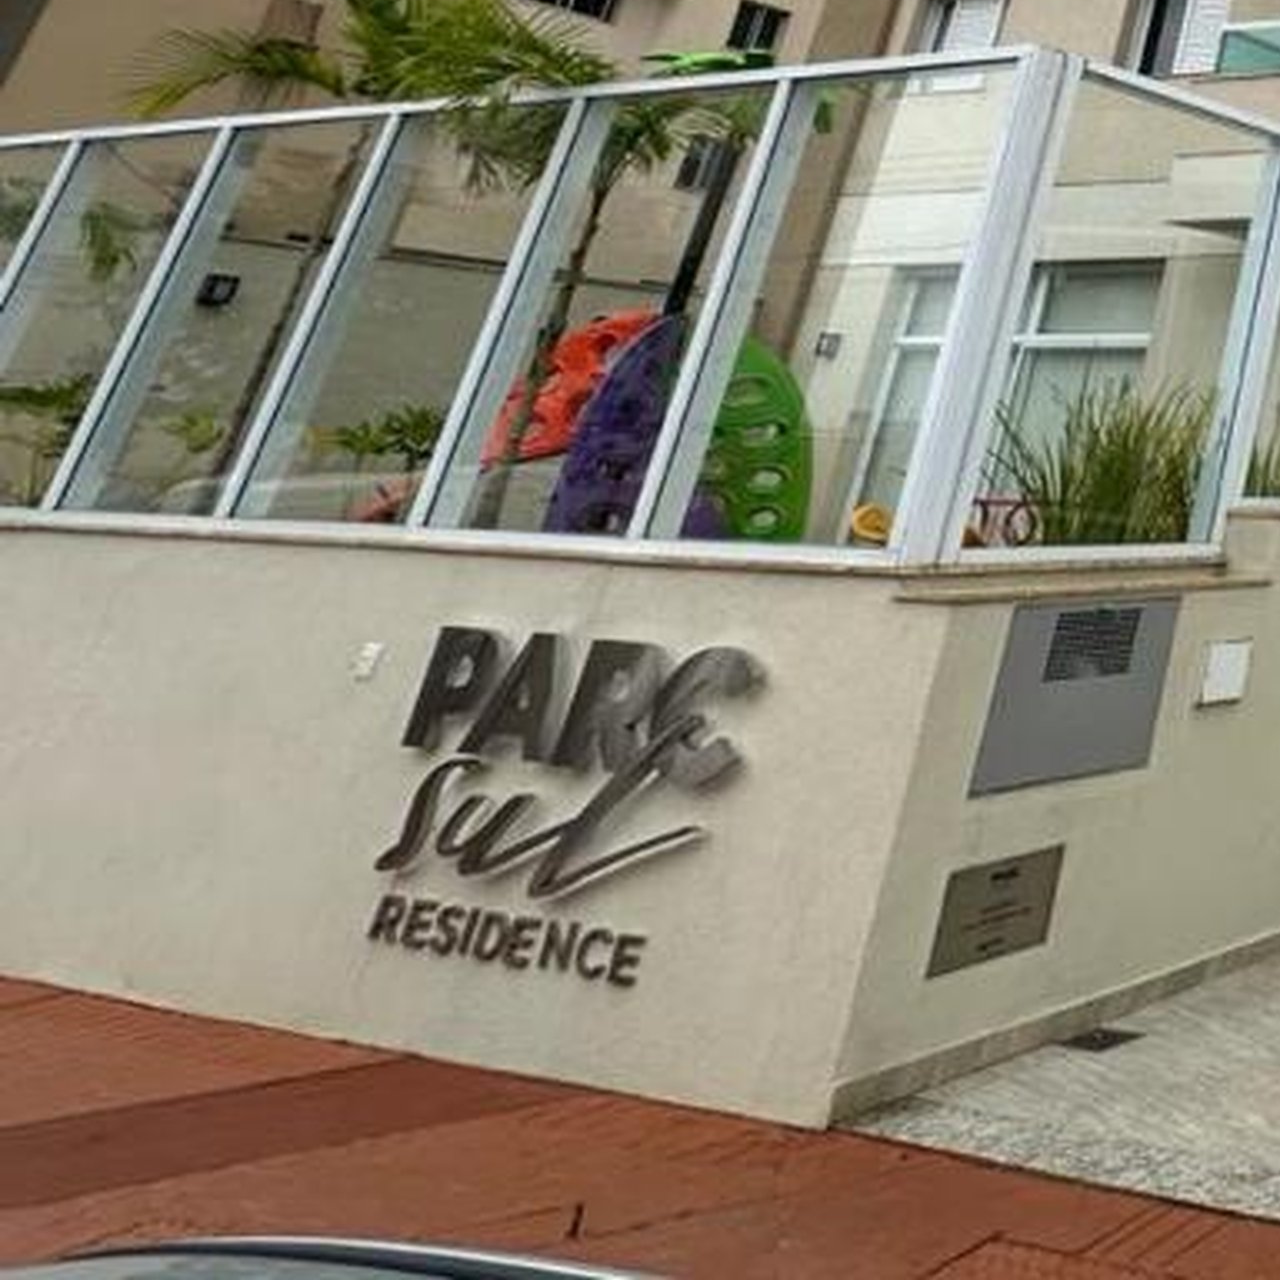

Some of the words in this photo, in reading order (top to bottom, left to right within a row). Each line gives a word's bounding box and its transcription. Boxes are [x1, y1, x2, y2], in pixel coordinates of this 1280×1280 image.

[402, 625, 770, 790] PARC
[374, 714, 706, 899] Sul
[367, 893, 648, 987] RESIDENCE
